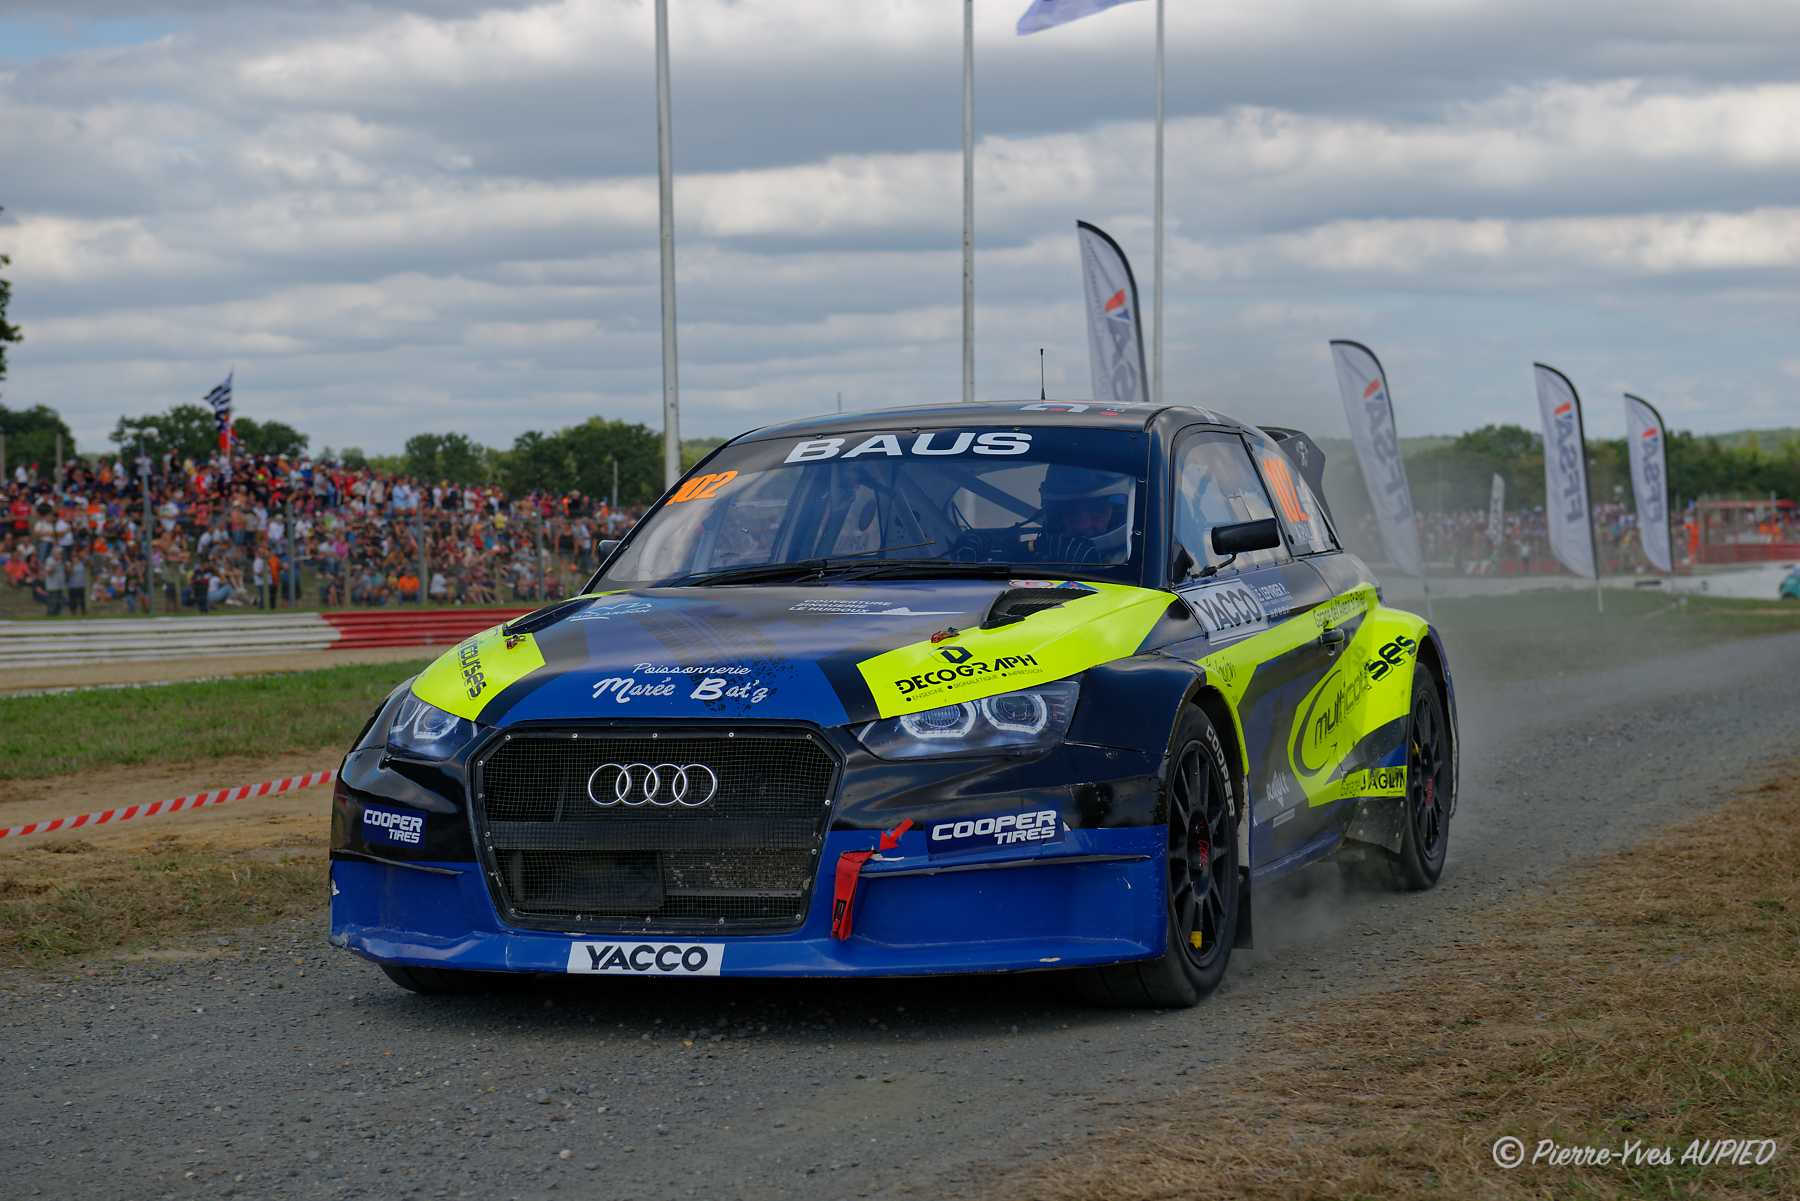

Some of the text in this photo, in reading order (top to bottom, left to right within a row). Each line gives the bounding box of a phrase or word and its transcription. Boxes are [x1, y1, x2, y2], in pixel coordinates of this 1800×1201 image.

[784, 432, 1033, 464] BAUS
[1194, 588, 1263, 632] YACCO
[632, 662, 751, 675] Poissonnerie
[895, 654, 1038, 694] DECOGRAPH
[592, 677, 769, 704] Marée Bat'z
[1207, 724, 1234, 817] COOPER
[363, 809, 423, 833] COOPER
[931, 810, 1057, 841] COOPER
[388, 828, 421, 844] TIRES
[994, 828, 1056, 845] TIRES
[585, 944, 709, 972] YACCO
